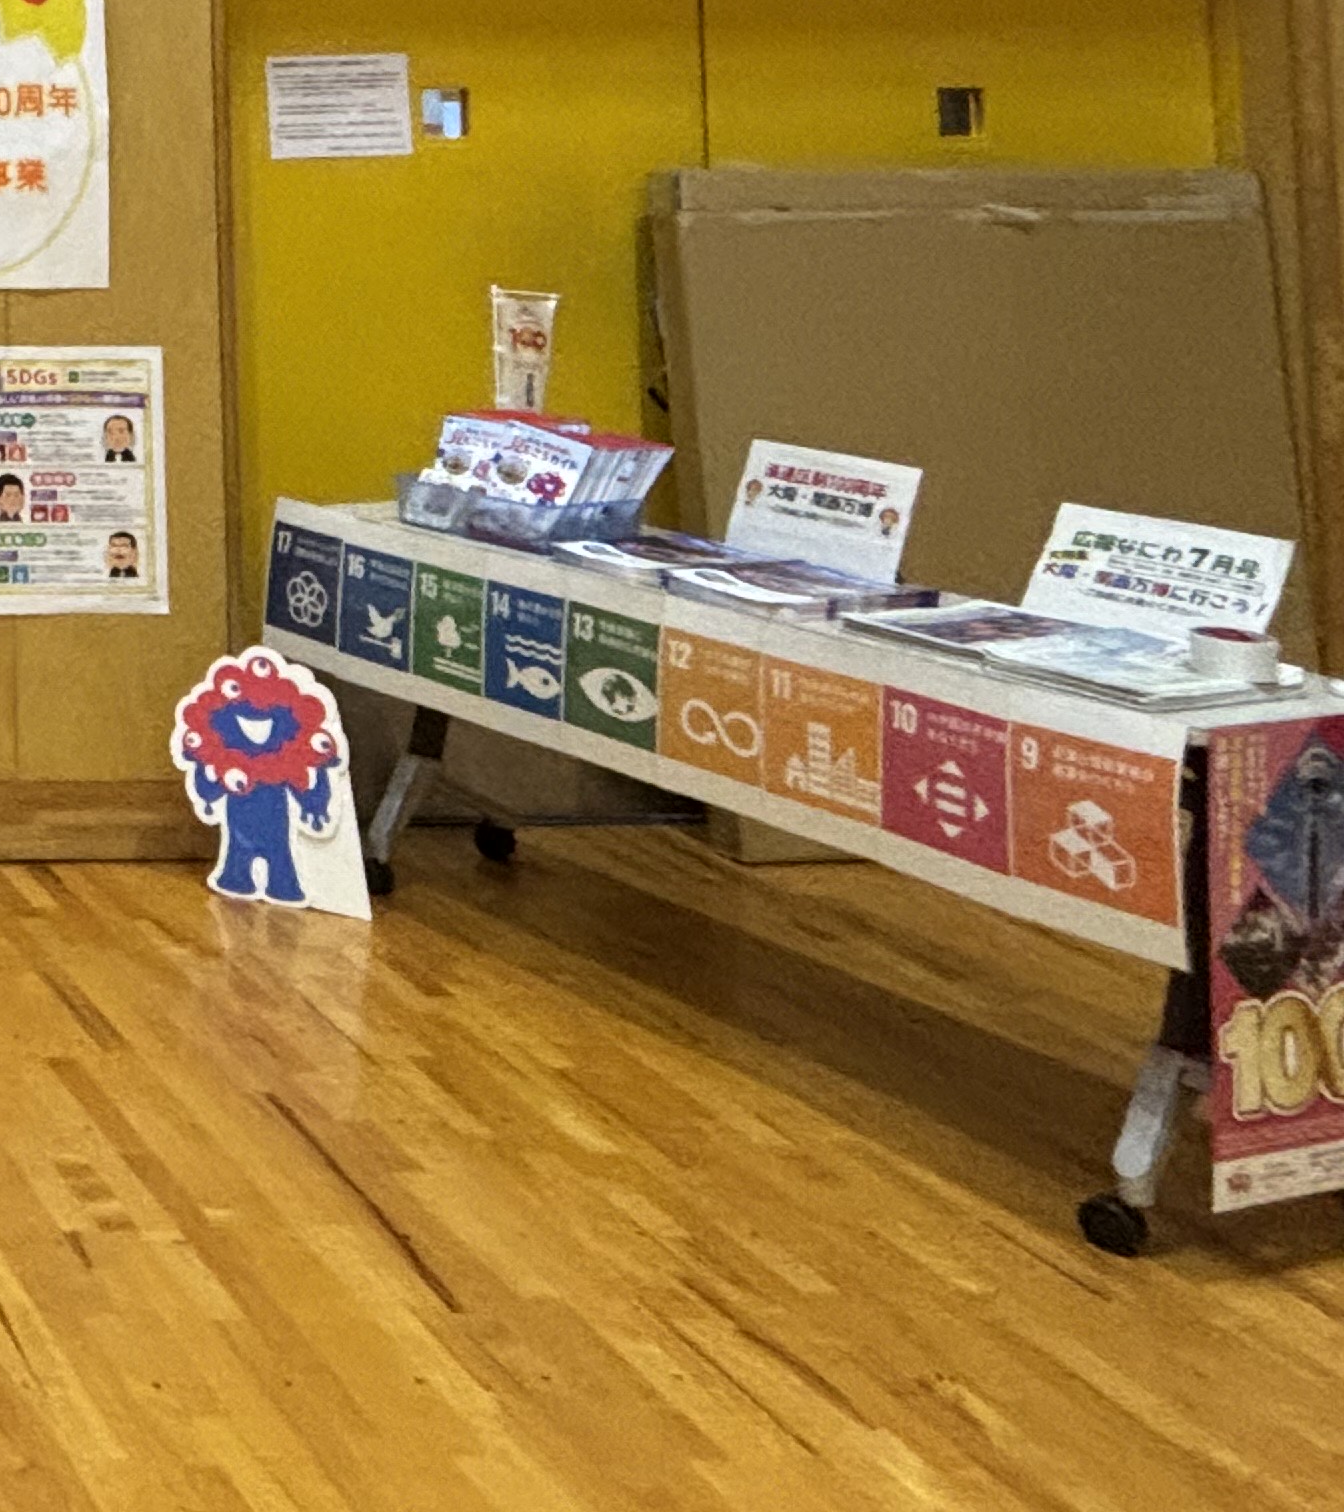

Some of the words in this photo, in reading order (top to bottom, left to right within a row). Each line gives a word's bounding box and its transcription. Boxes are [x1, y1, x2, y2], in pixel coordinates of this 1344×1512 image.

[6, 368, 59, 386] SDGs
[277, 531, 292, 553] 17
[347, 553, 365, 579] 16
[420, 572, 437, 600] 15
[491, 591, 510, 619] 14
[573, 613, 595, 641] 13
[668, 639, 692, 669] 12
[771, 668, 791, 700] 11
[890, 700, 917, 734] 10
[1021, 736, 1039, 770] 9
